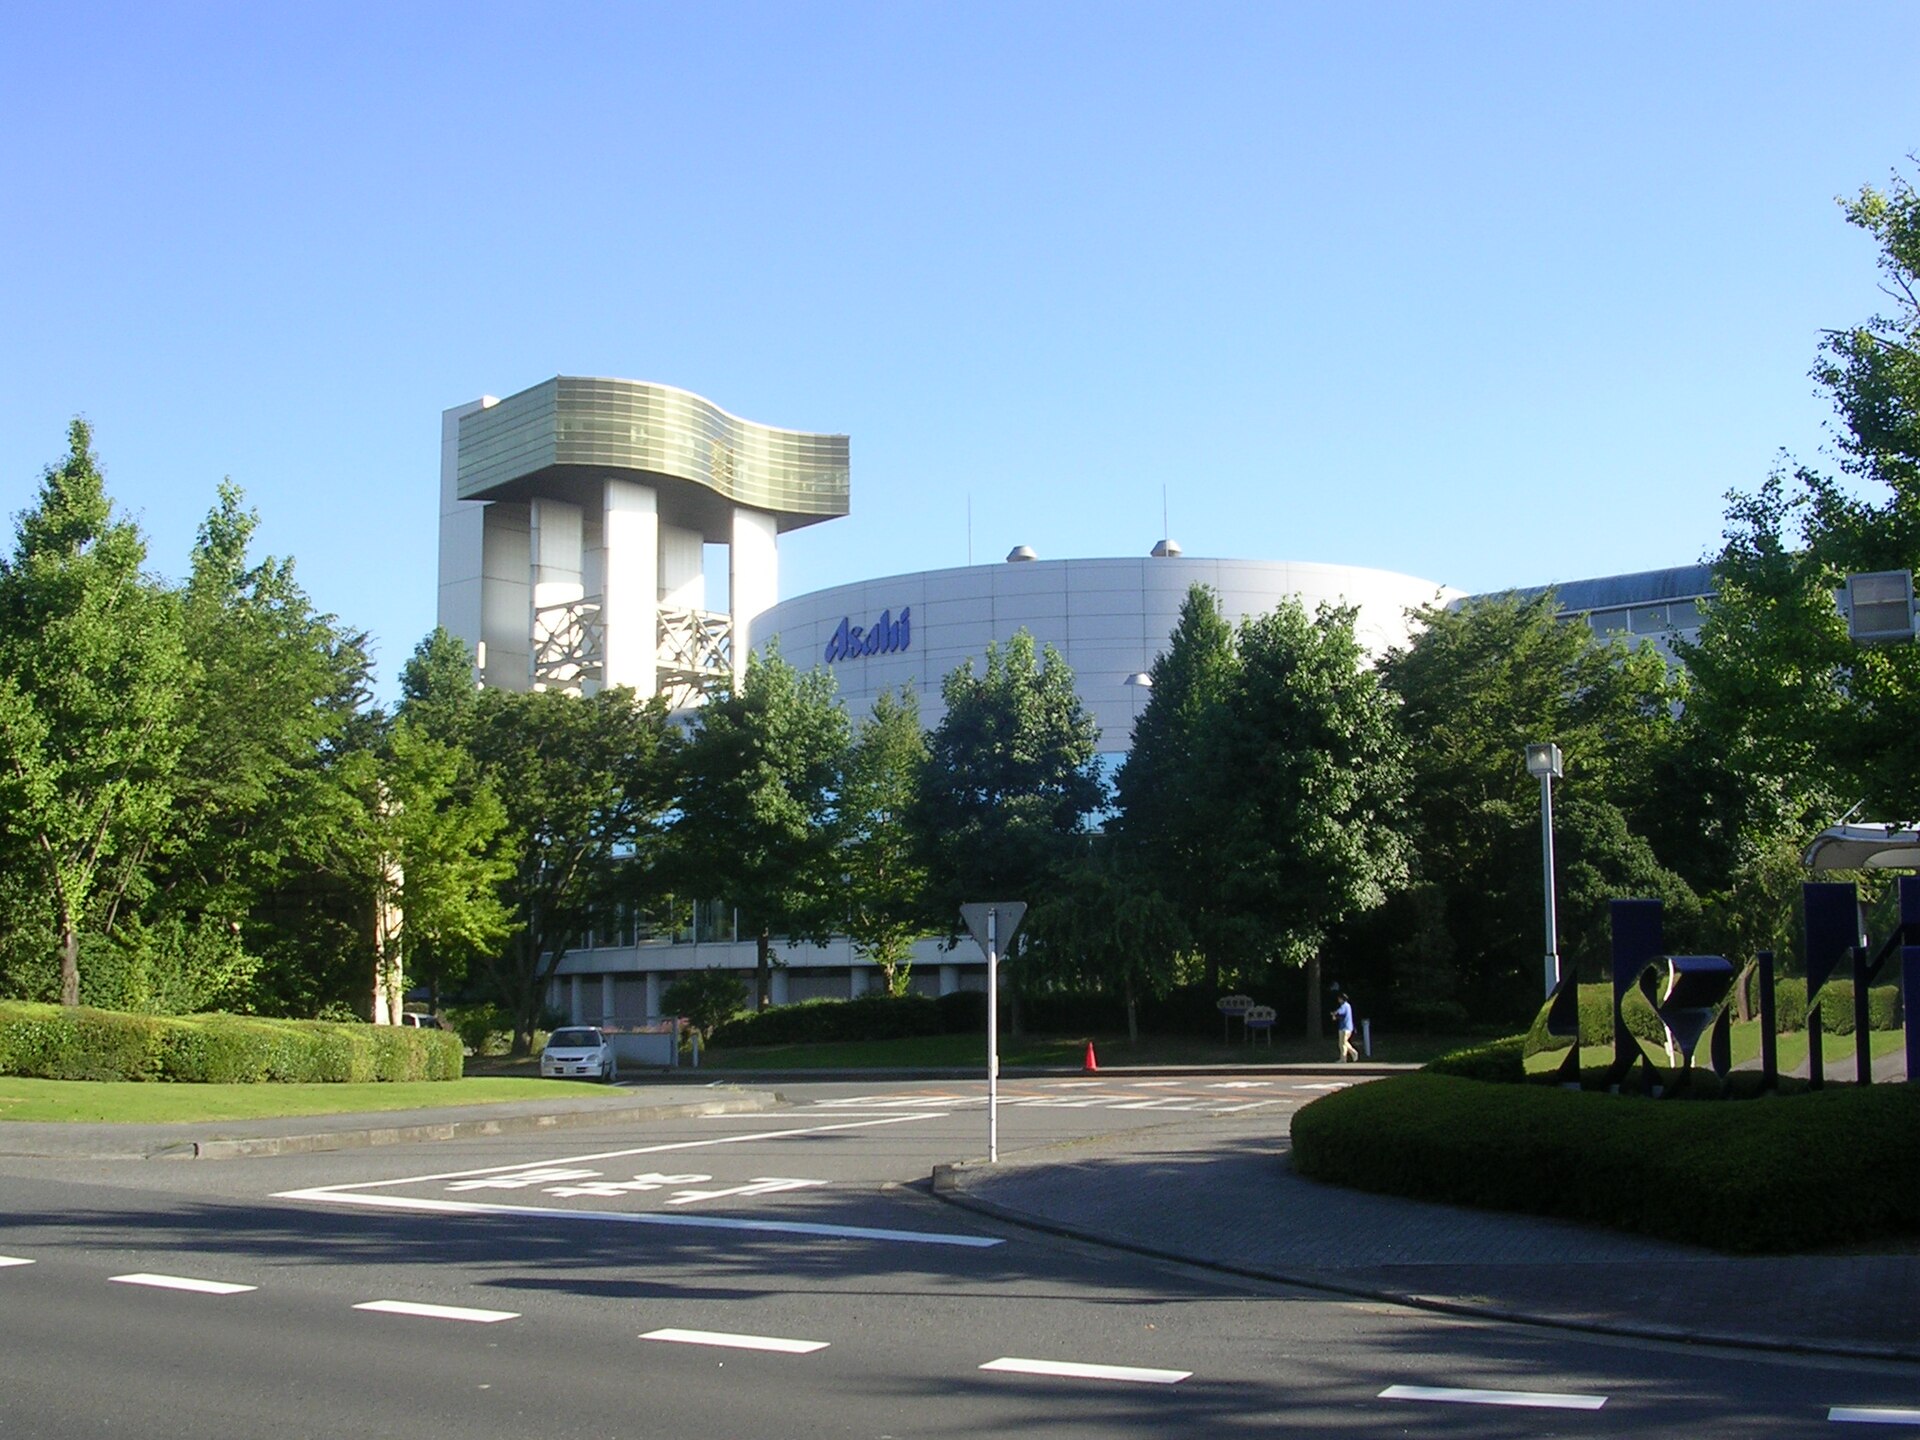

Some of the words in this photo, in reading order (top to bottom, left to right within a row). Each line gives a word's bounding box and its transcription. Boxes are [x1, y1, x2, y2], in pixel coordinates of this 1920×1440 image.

[824, 606, 910, 663] Asahi
[444, 1167, 829, 1205] 止まれ
